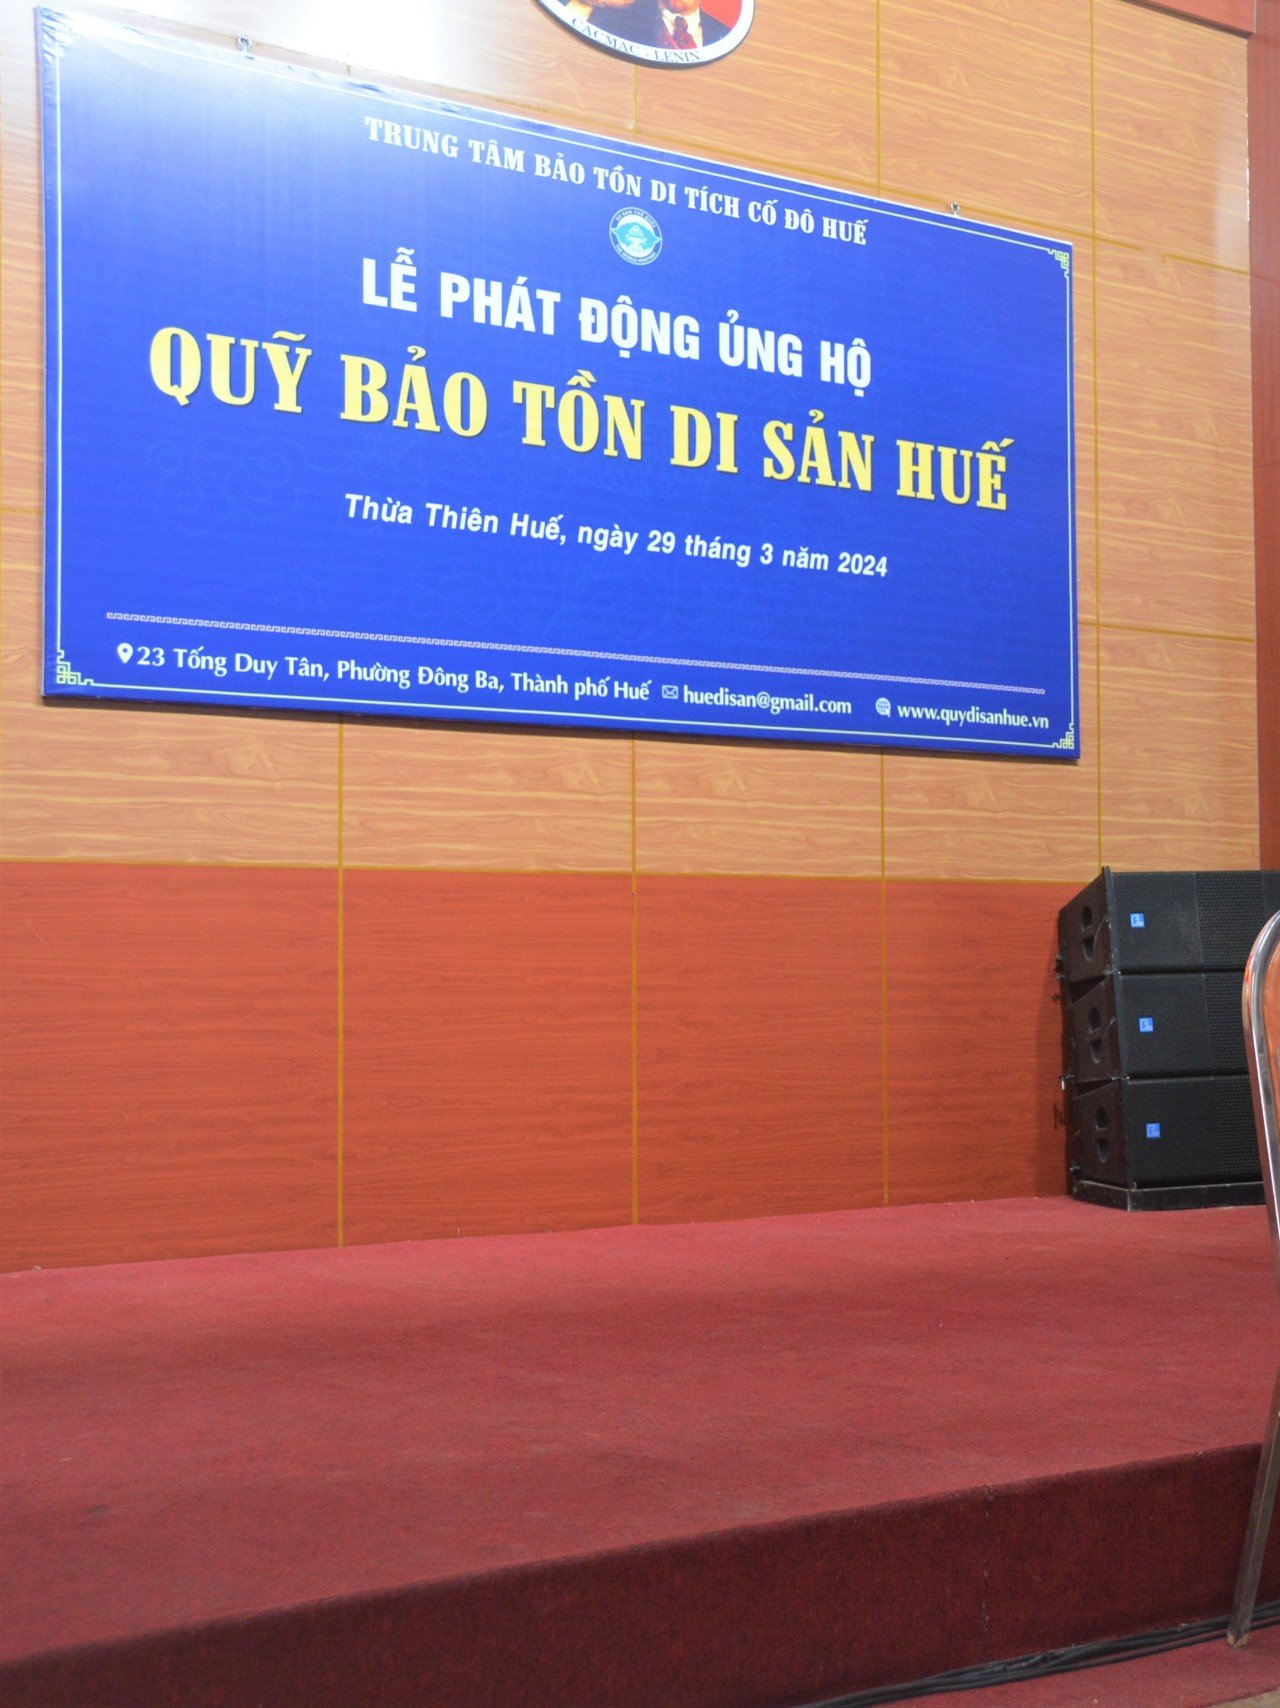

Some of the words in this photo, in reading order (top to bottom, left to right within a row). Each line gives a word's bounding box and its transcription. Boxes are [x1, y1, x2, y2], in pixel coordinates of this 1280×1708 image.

[363, 116, 459, 158] TRUNG
[468, 139, 524, 172] TÂM
[535, 153, 585, 184] BẢO
[593, 165, 641, 197] TỒN
[651, 180, 676, 204] DI
[685, 186, 739, 218] TÍCH
[748, 200, 778, 225] CỐ
[785, 209, 814, 233] ĐÔ
[823, 217, 868, 245] HUẾ
[363, 247, 417, 312] LỄ
[441, 272, 560, 335] PHÁT
[579, 295, 699, 359] ĐỘNG
[719, 310, 802, 377] ỦNG
[821, 338, 871, 396] HỘ
[150, 327, 311, 412] QUỸ
[341, 346, 487, 436] BẢO
[513, 370, 644, 459] TỒN
[671, 405, 737, 473] DI
[764, 410, 874, 491] SẢN
[897, 439, 1014, 510] HUẾ
[345, 494, 412, 524] Thừa
[426, 503, 498, 533] Thiên
[511, 513, 565, 545] Huế,
[578, 524, 638, 554] ngày
[647, 530, 675, 553] 29
[685, 535, 751, 567] tháng
[760, 543, 773, 564] 3
[783, 547, 828, 570] năm
[838, 552, 887, 576] 2024
[137, 647, 164, 666] 23
[174, 646, 227, 676] Tống
[235, 653, 277, 680] Duy
[285, 657, 329, 681] Tân,
[338, 660, 410, 689] Phường
[418, 666, 469, 693] Đông
[476, 671, 504, 693] Ba,
[511, 672, 568, 694] Thành
[575, 677, 610, 700] phố
[614, 680, 652, 700] Huế
[684, 685, 851, 714] huedisan@gmail.com
[897, 706, 1049, 728] www.quydisanhue.vn
